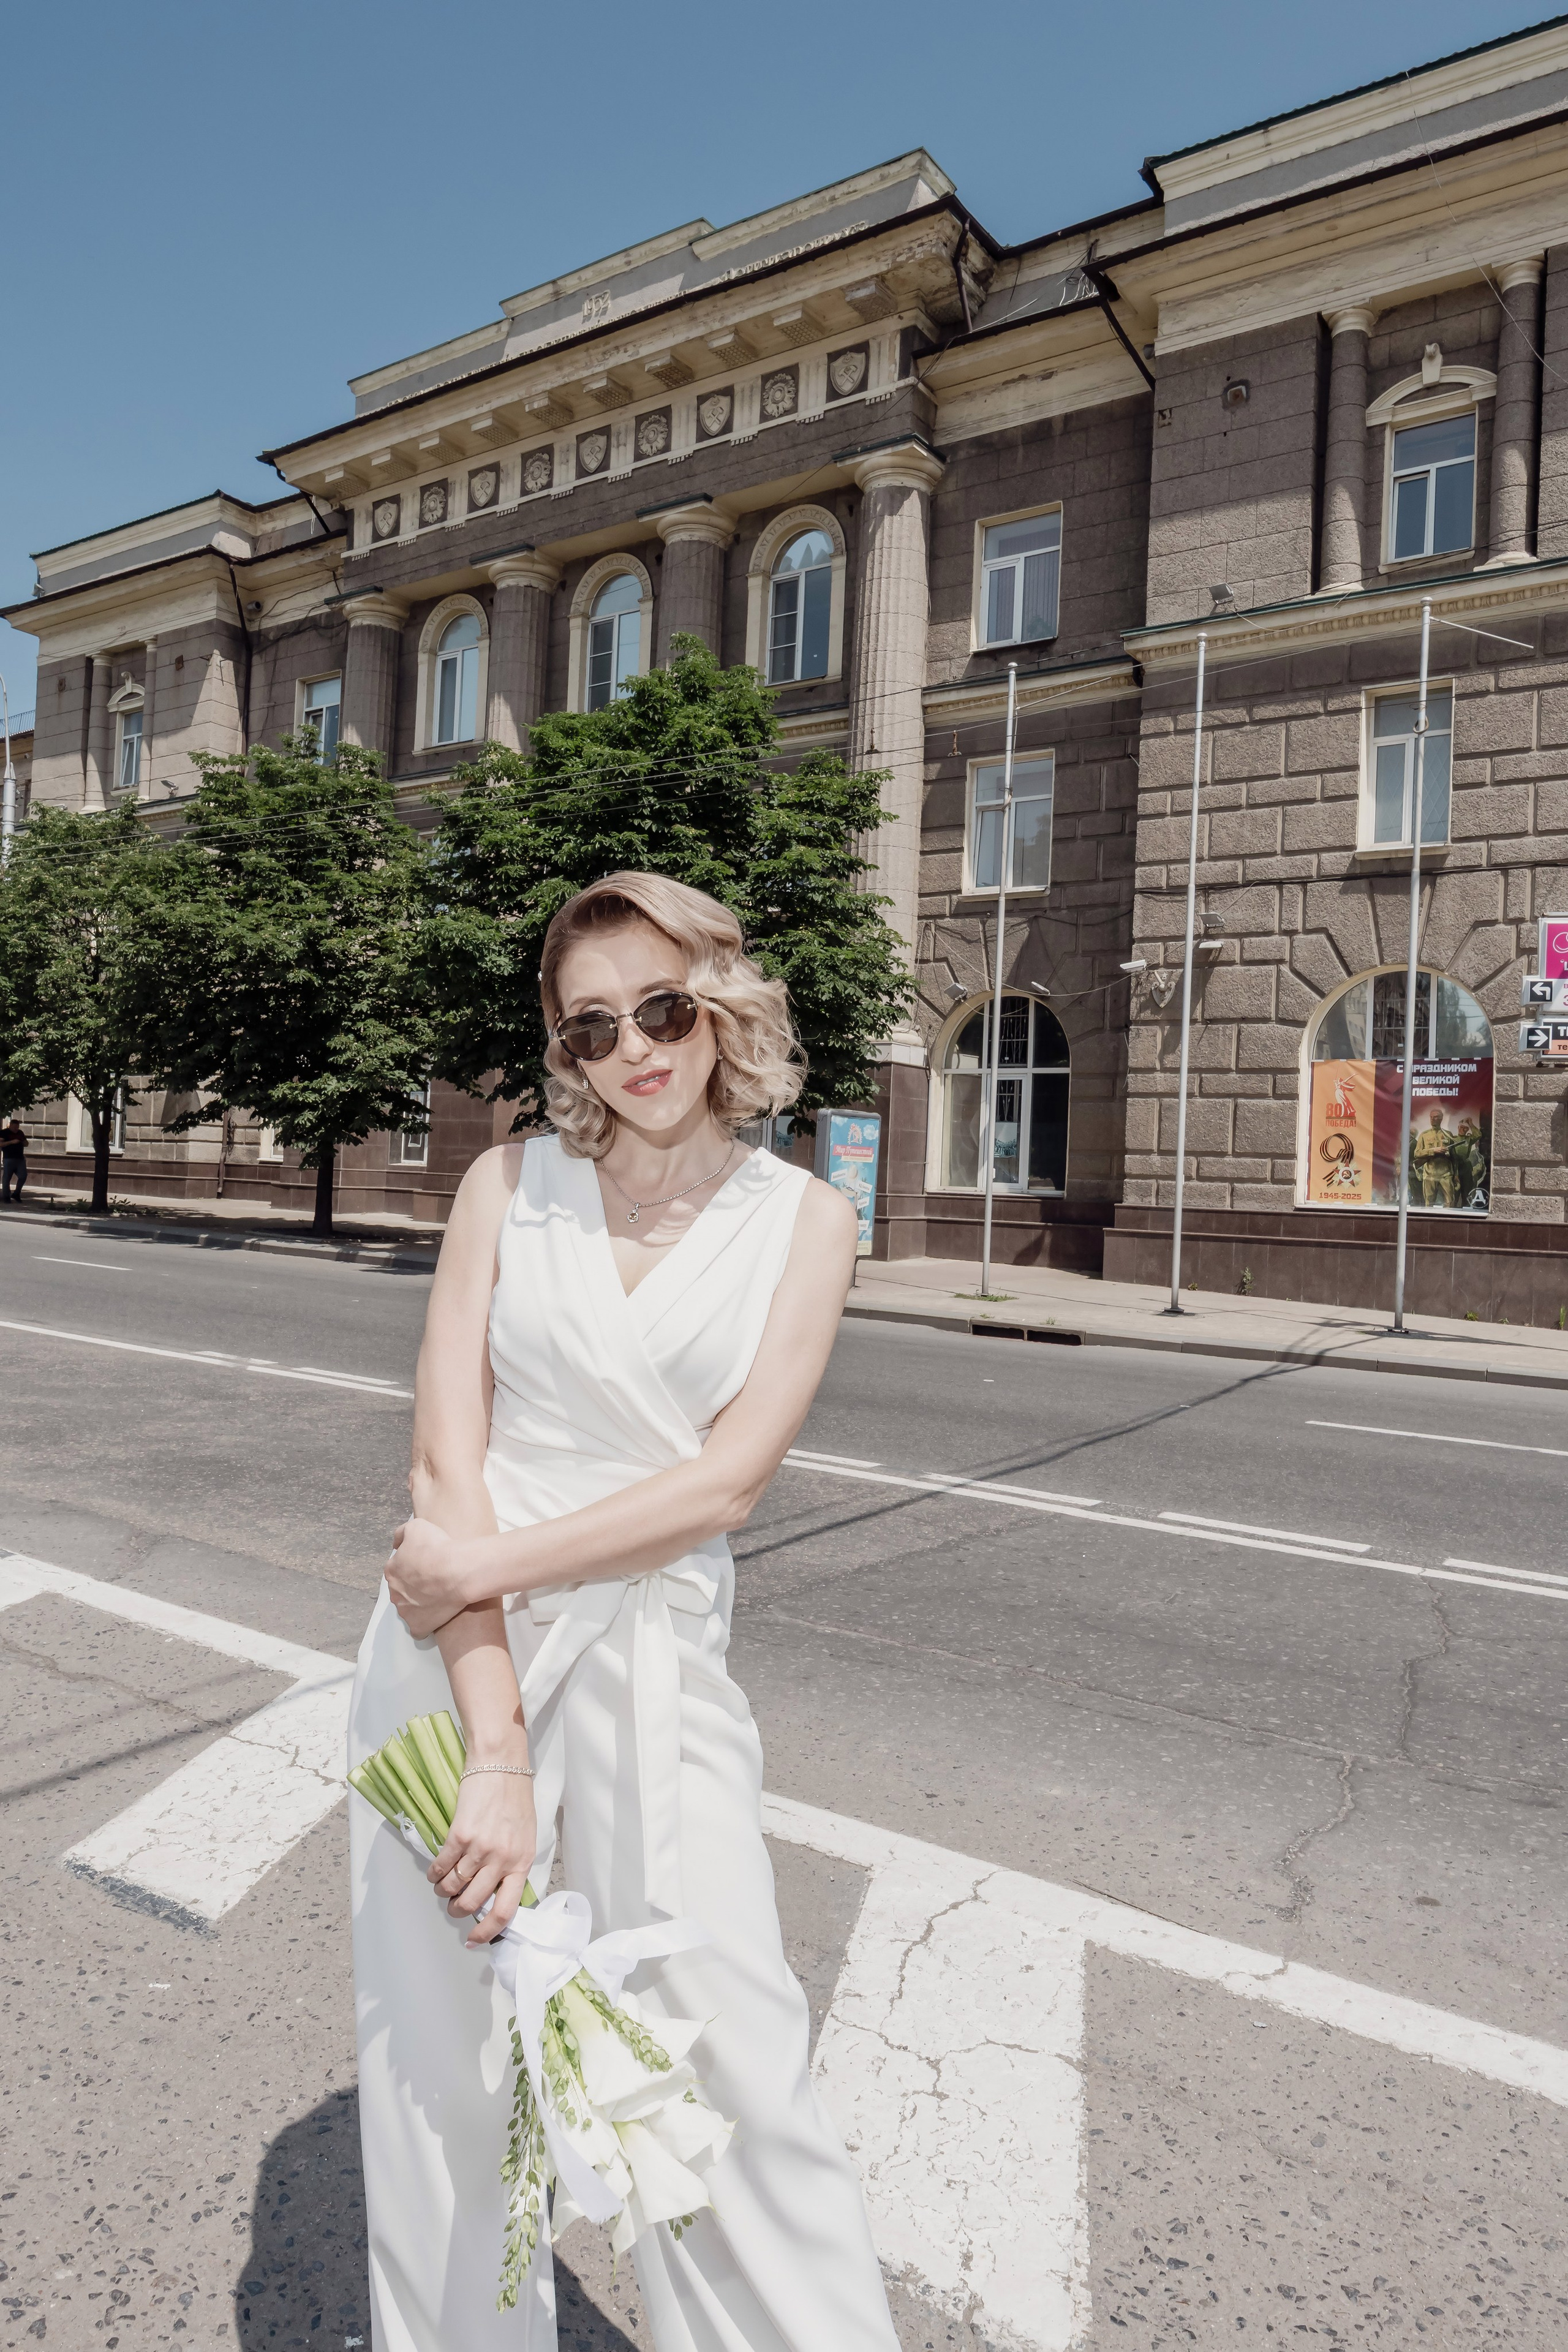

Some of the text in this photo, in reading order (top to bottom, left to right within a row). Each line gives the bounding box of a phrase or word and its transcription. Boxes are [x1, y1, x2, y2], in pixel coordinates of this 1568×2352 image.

[582, 290, 610, 317] 1952
[1412, 1074, 1460, 1085] ВЕЛИКОЙ
[1412, 1088, 1458, 1096] ПОБЕДЫ!
[1326, 1103, 1343, 1117] 80
[1325, 1120, 1356, 1128] ПОБЕДА!
